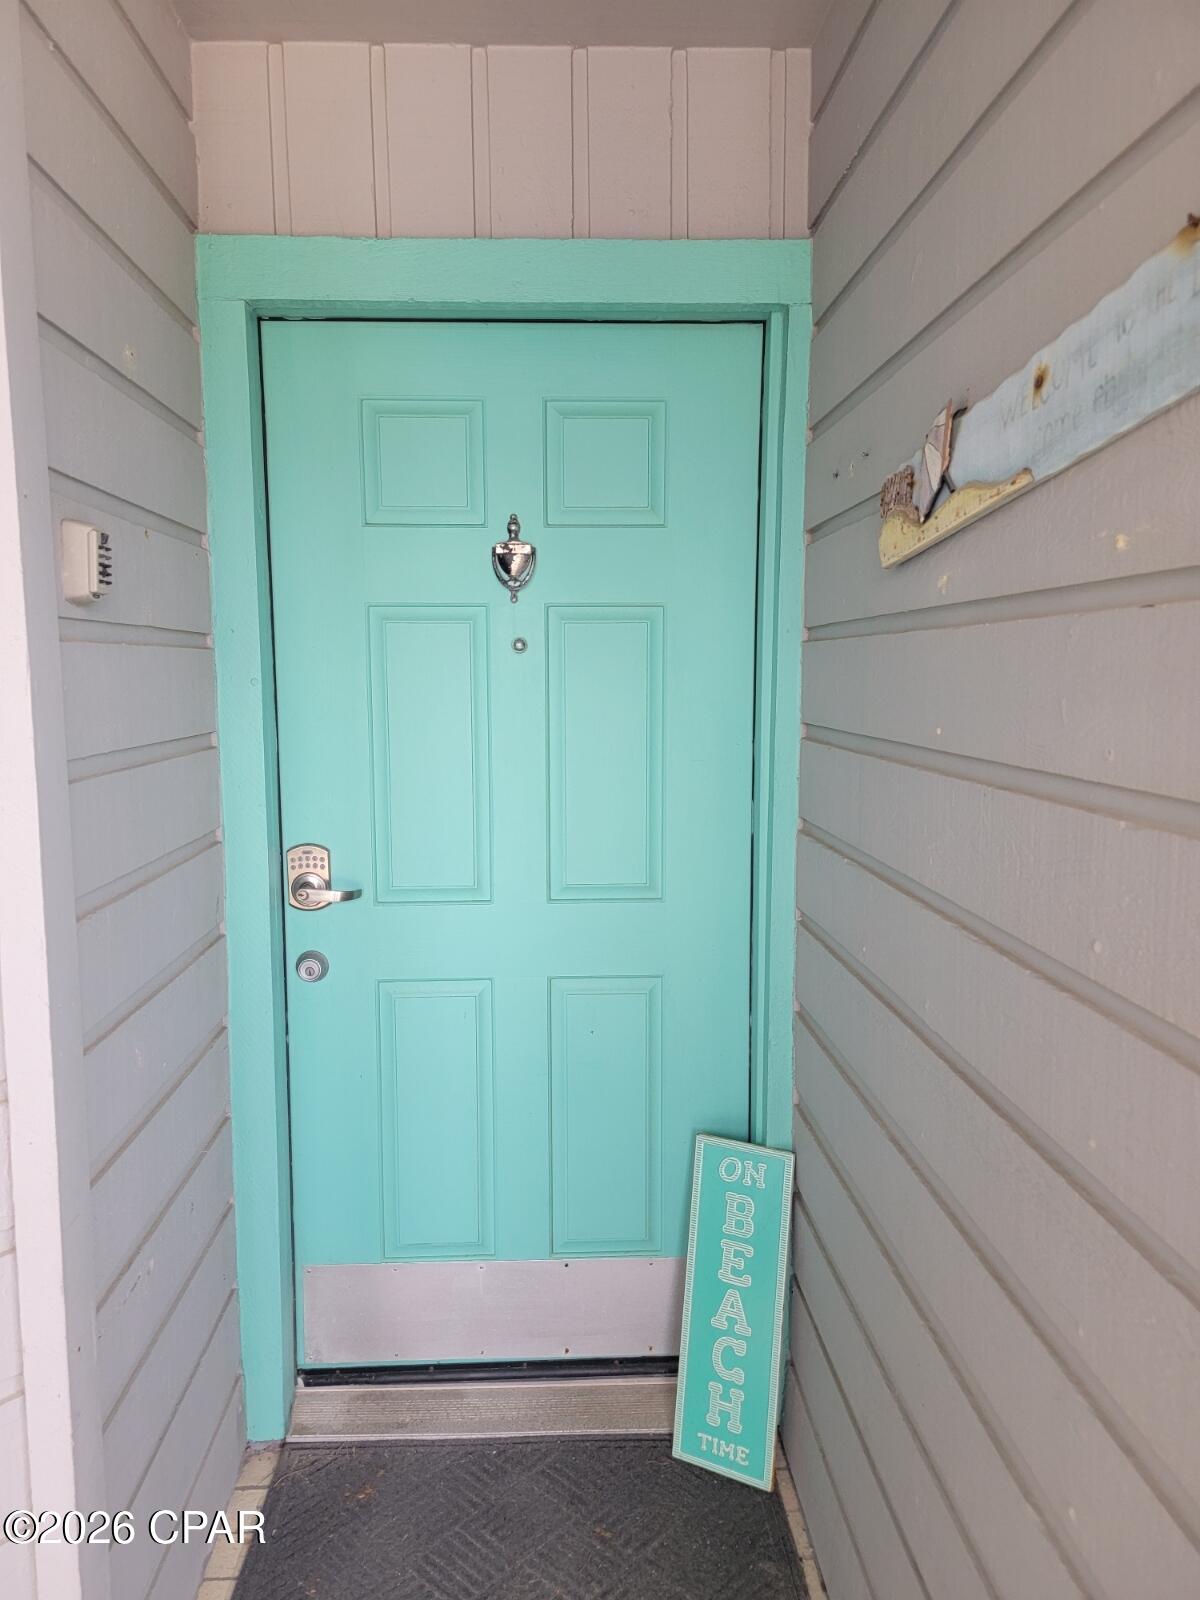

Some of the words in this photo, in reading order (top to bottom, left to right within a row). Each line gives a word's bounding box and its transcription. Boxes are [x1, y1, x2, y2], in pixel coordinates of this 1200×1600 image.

[718, 1156, 767, 1189] ON
[706, 1191, 755, 1434] BEACH
[697, 1432, 750, 1467] TIME
